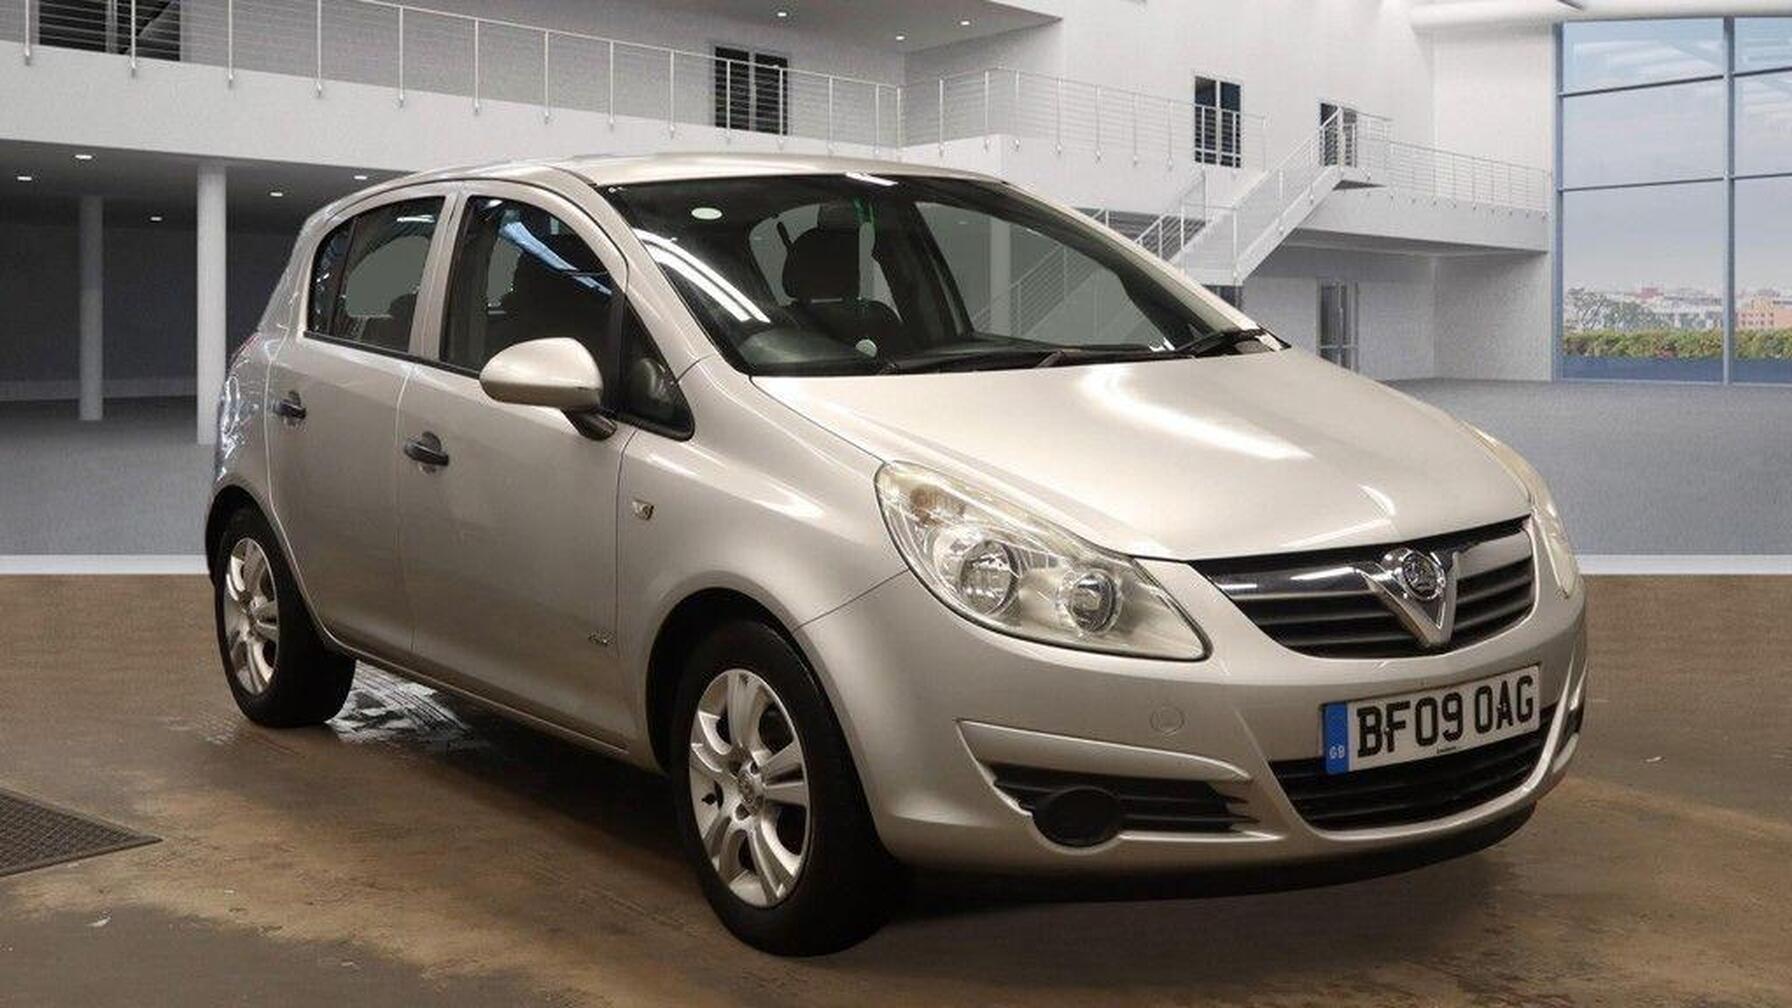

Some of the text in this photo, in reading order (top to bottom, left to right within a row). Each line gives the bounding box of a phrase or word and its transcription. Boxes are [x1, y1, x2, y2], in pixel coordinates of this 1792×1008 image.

[1357, 676, 1533, 757] BF09 OAG
[1329, 745, 1345, 760] GB
